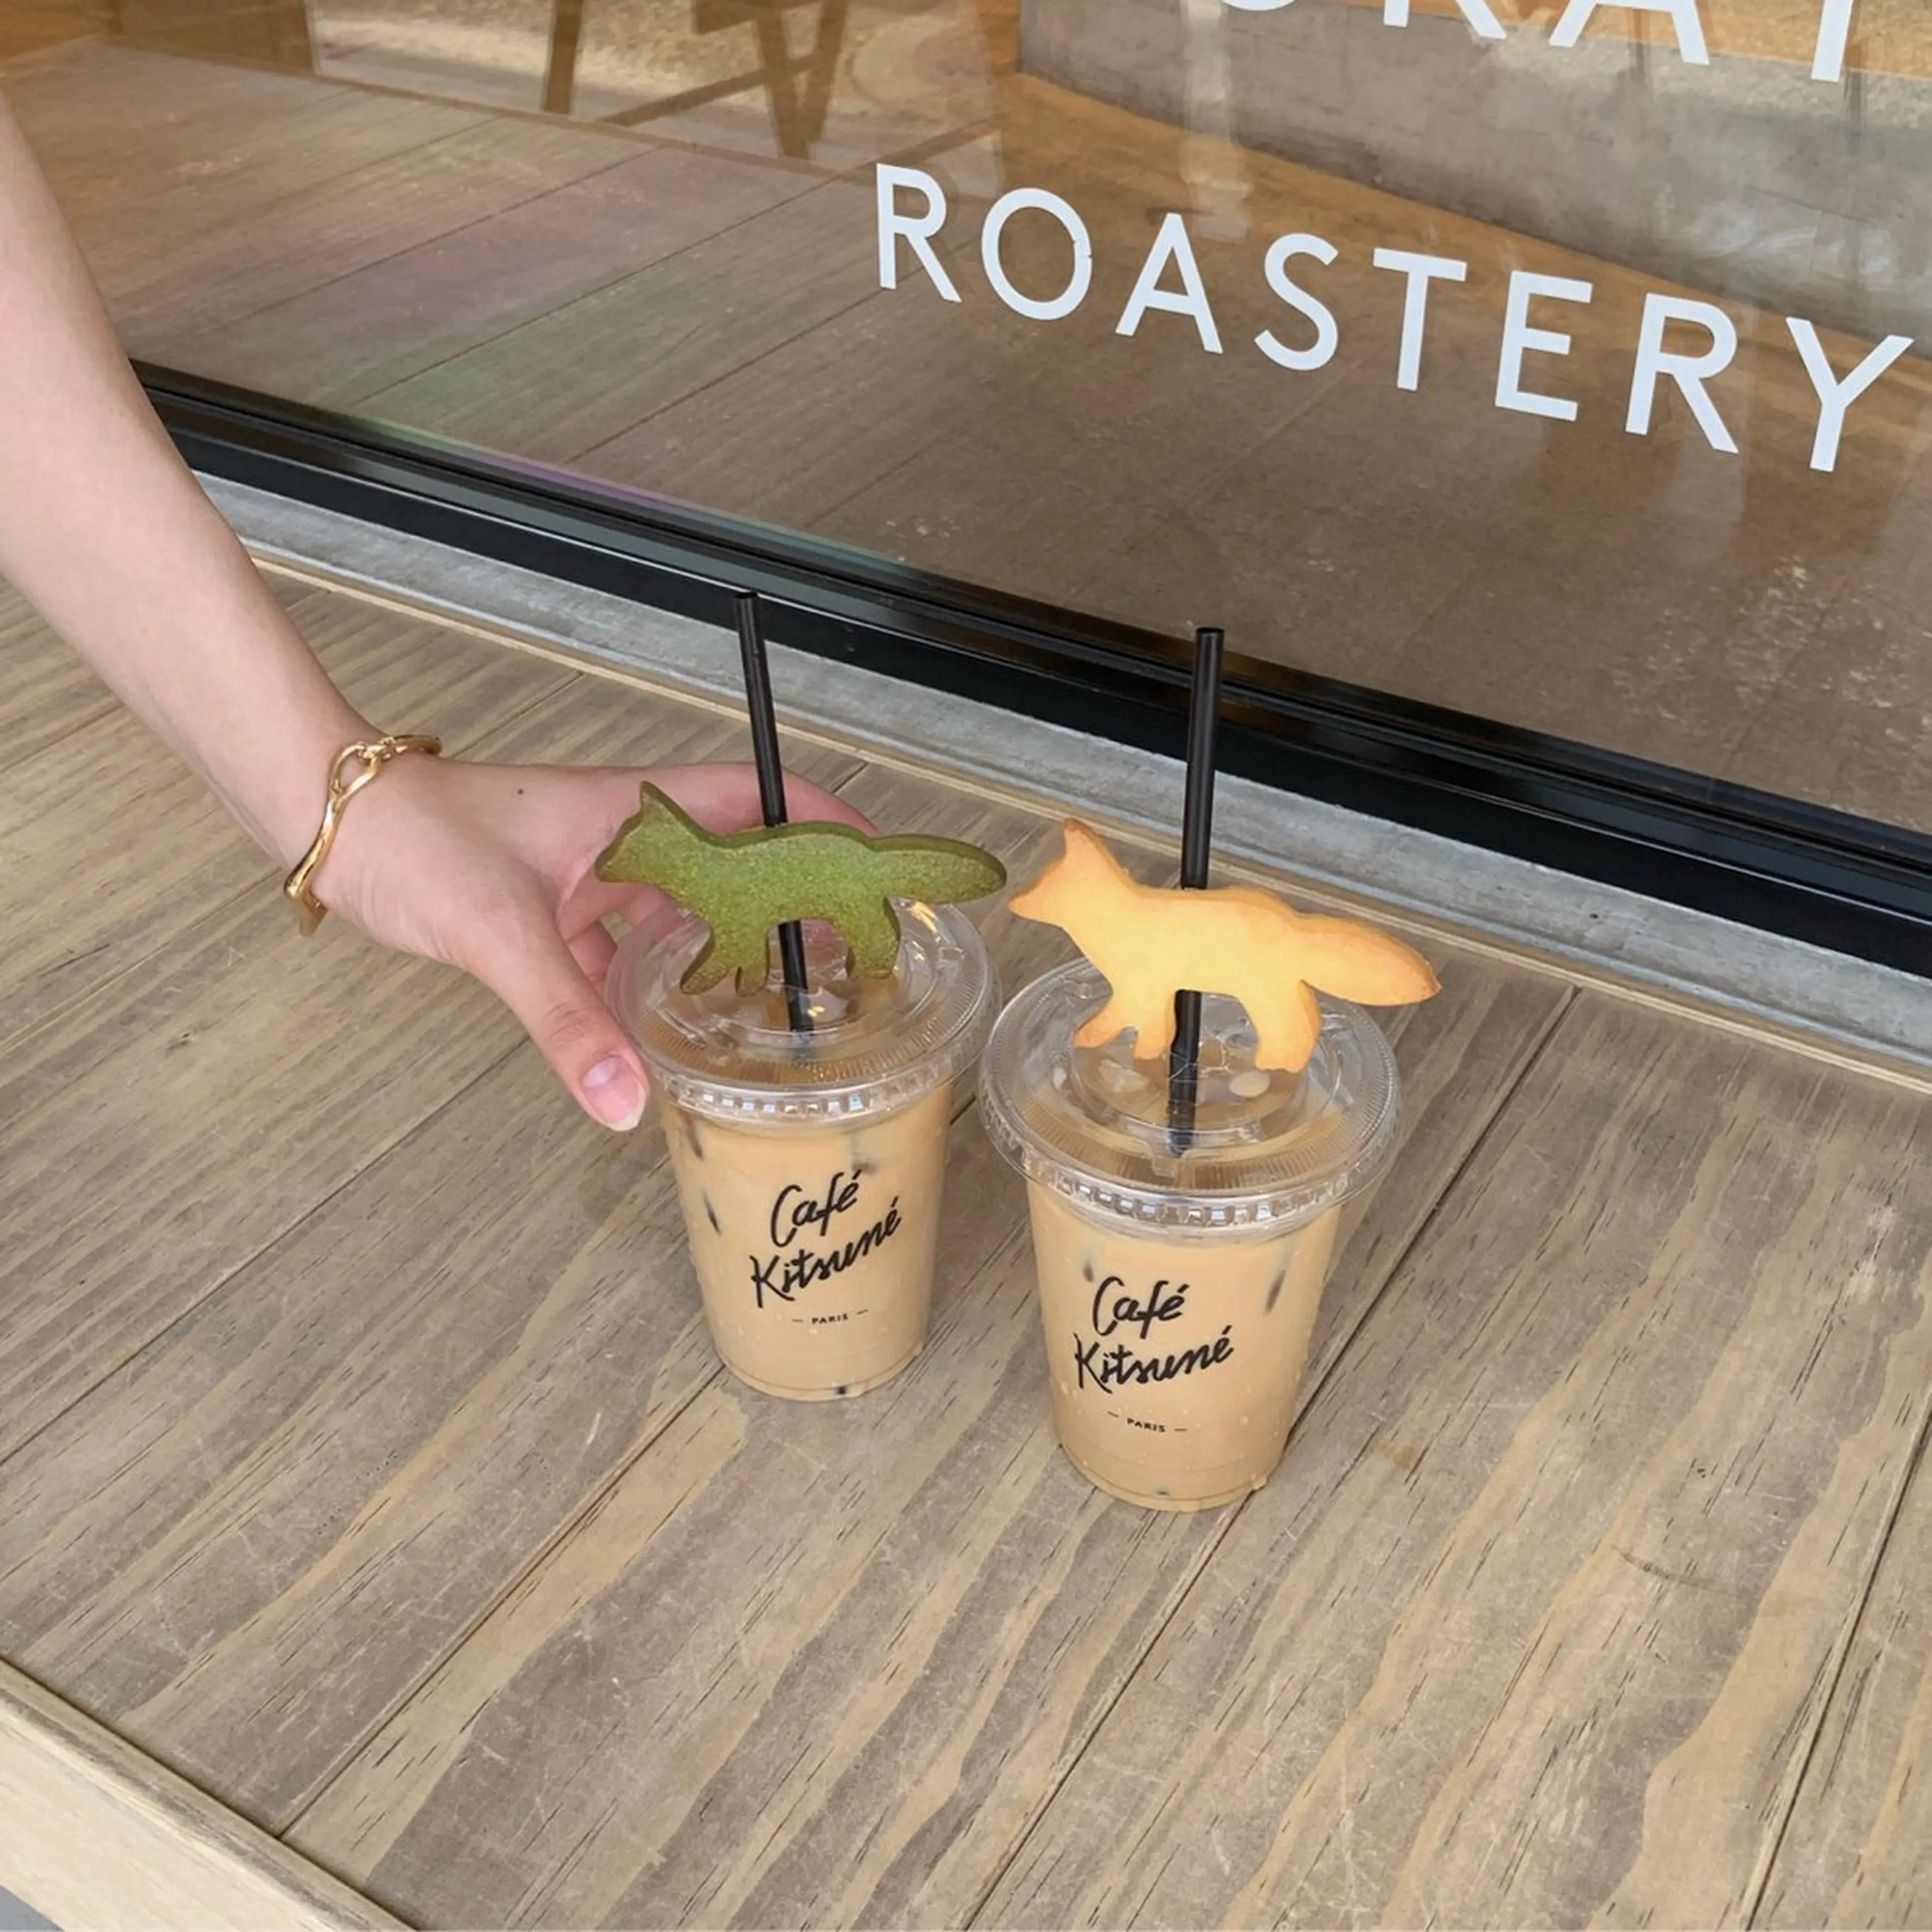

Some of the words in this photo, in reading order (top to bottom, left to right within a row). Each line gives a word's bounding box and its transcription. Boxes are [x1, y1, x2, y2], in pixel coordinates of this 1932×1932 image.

[876, 163, 1914, 472] ROASTERY
[770, 1169, 863, 1248] Café
[749, 1195, 902, 1309] Kitsuné
[811, 1313, 849, 1325] PARIS
[1092, 1276, 1189, 1340] Café
[1073, 1324, 1234, 1394] Kitsuné
[1126, 1417, 1166, 1433] PARIS
